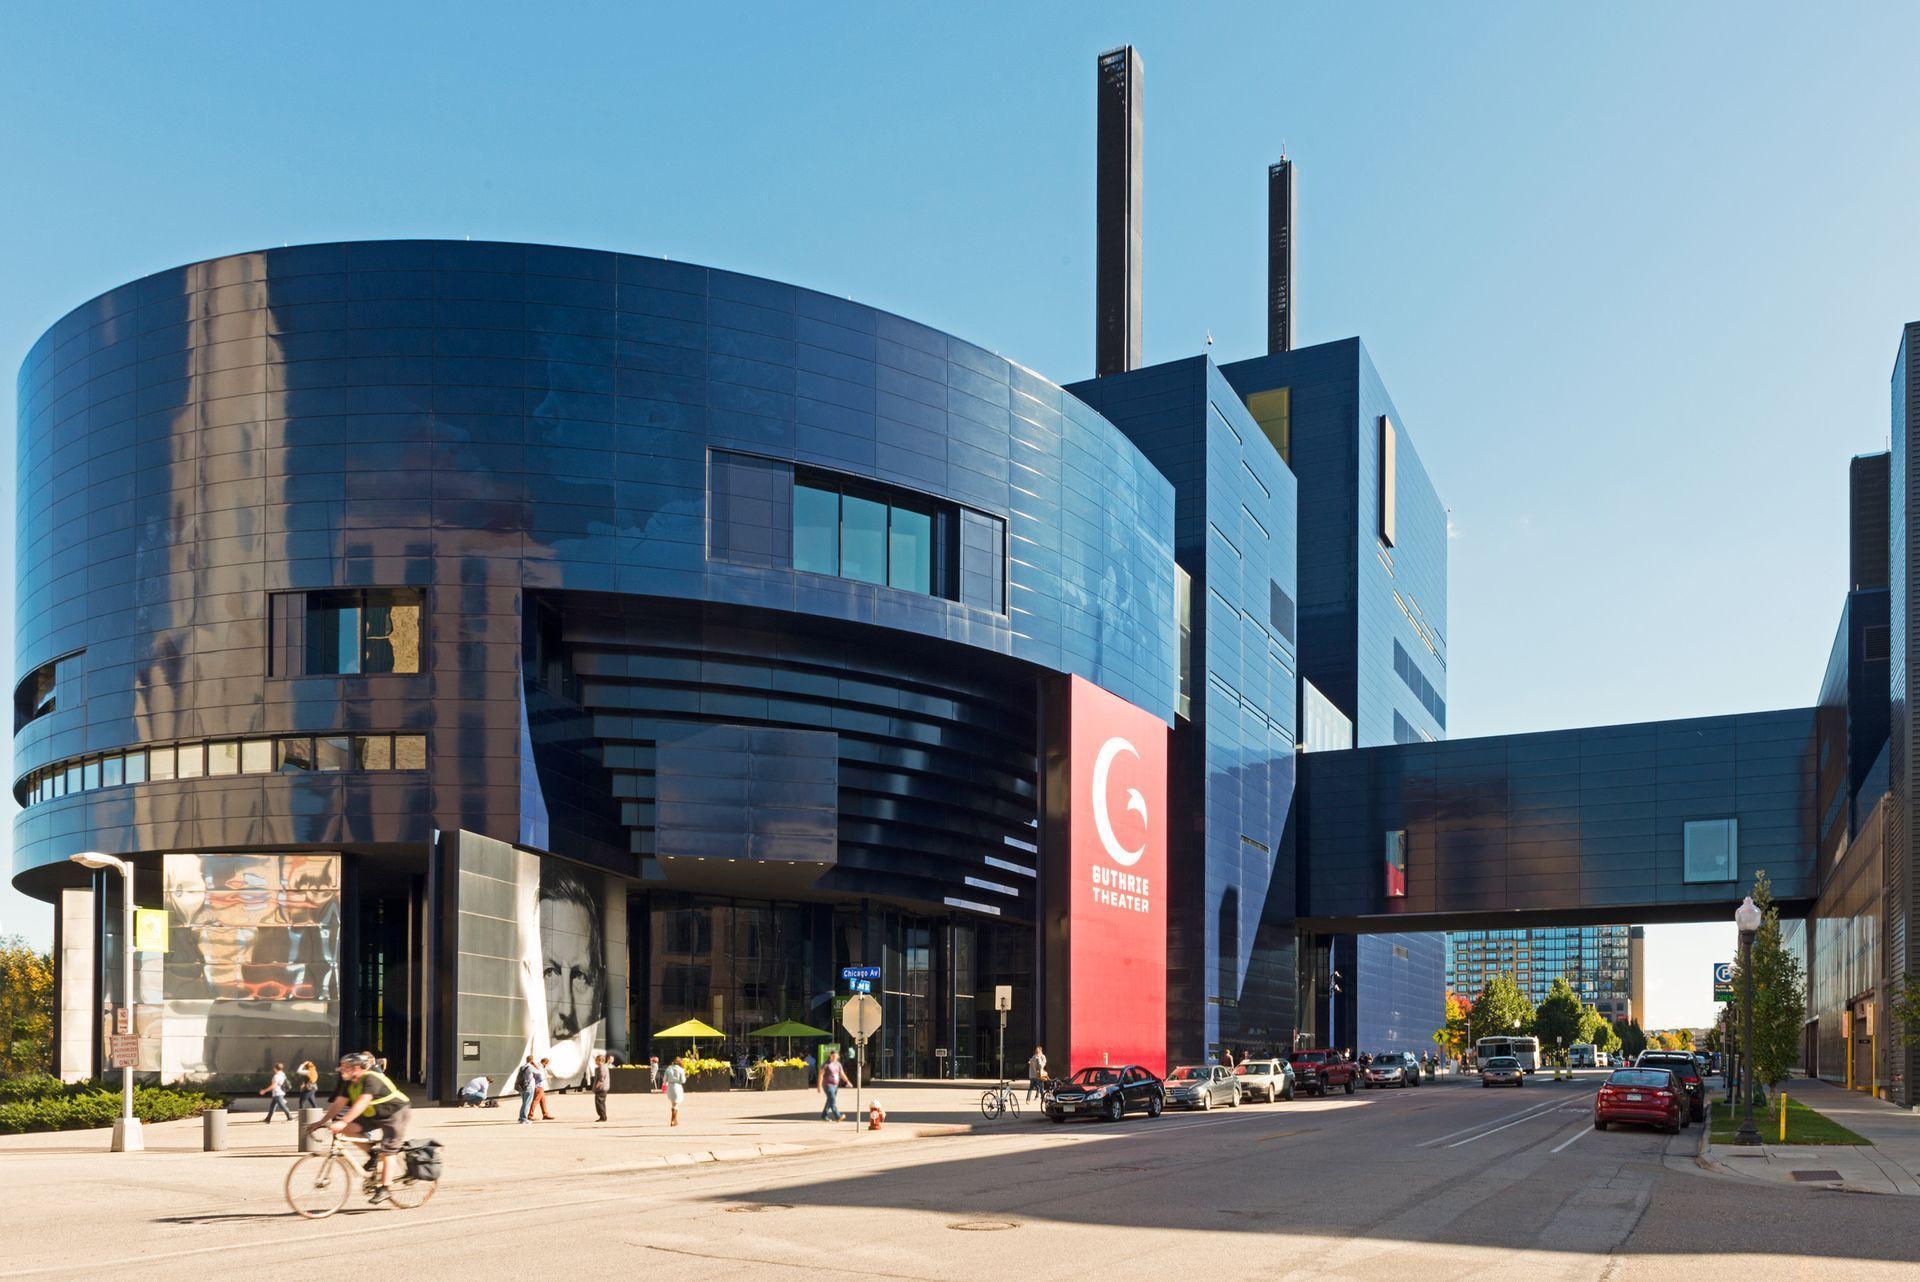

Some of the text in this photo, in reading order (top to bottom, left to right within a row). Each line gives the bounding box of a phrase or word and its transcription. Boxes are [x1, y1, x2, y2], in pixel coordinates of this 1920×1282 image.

[1092, 864, 1149, 896] GUTHRIE
[1092, 886, 1149, 913] THEATER
[843, 970, 868, 978] Chicago
